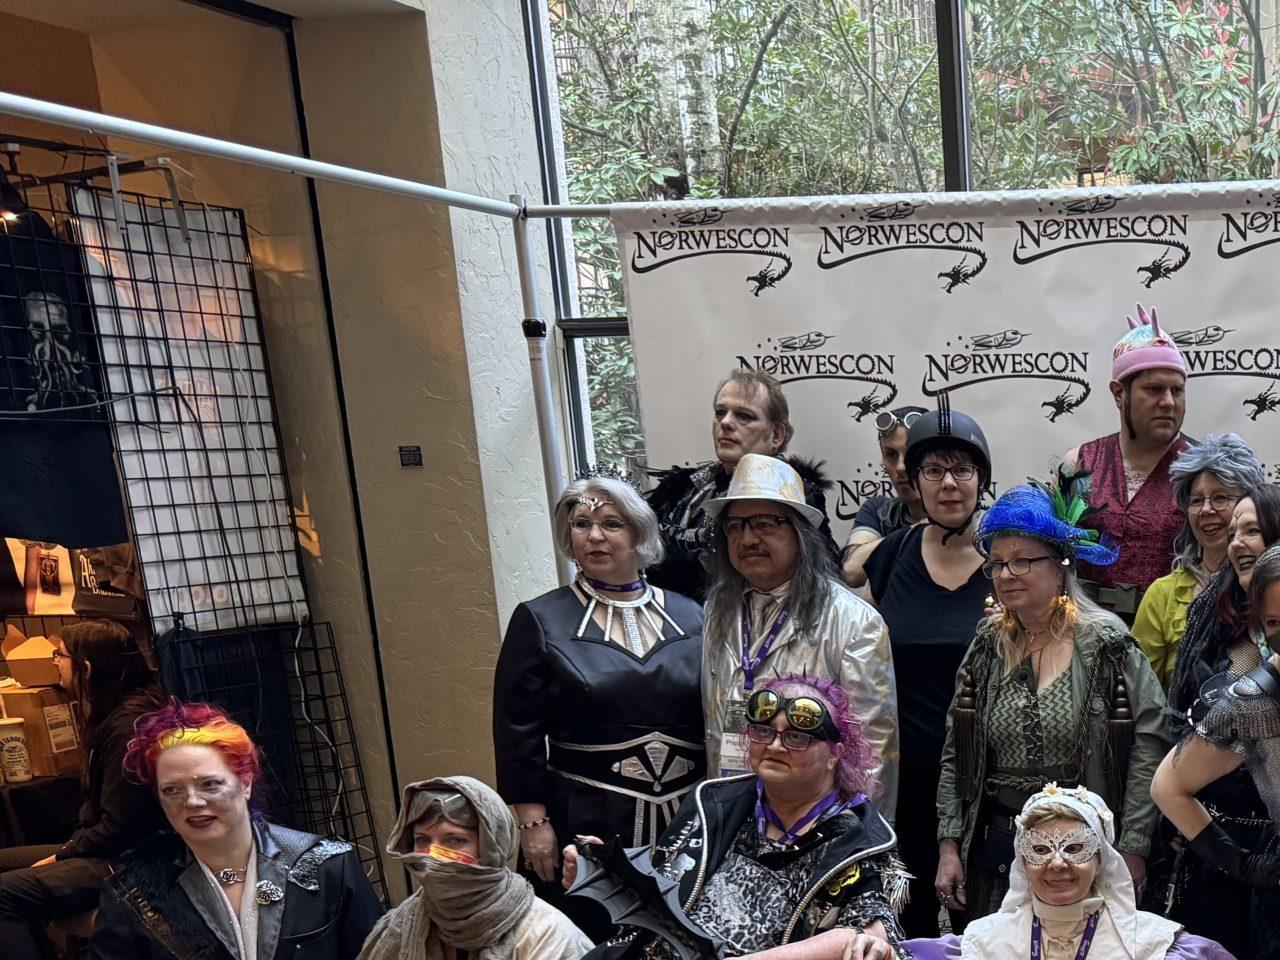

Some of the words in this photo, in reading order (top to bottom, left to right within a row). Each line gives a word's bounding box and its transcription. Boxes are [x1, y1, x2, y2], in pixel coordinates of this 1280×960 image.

[633, 227, 790, 259] NORWESCON
[819, 221, 985, 255] NORWESCON
[1016, 214, 1189, 249] NORWESCON
[736, 353, 895, 375] NORWESCON
[924, 351, 1089, 382] NORWESCON
